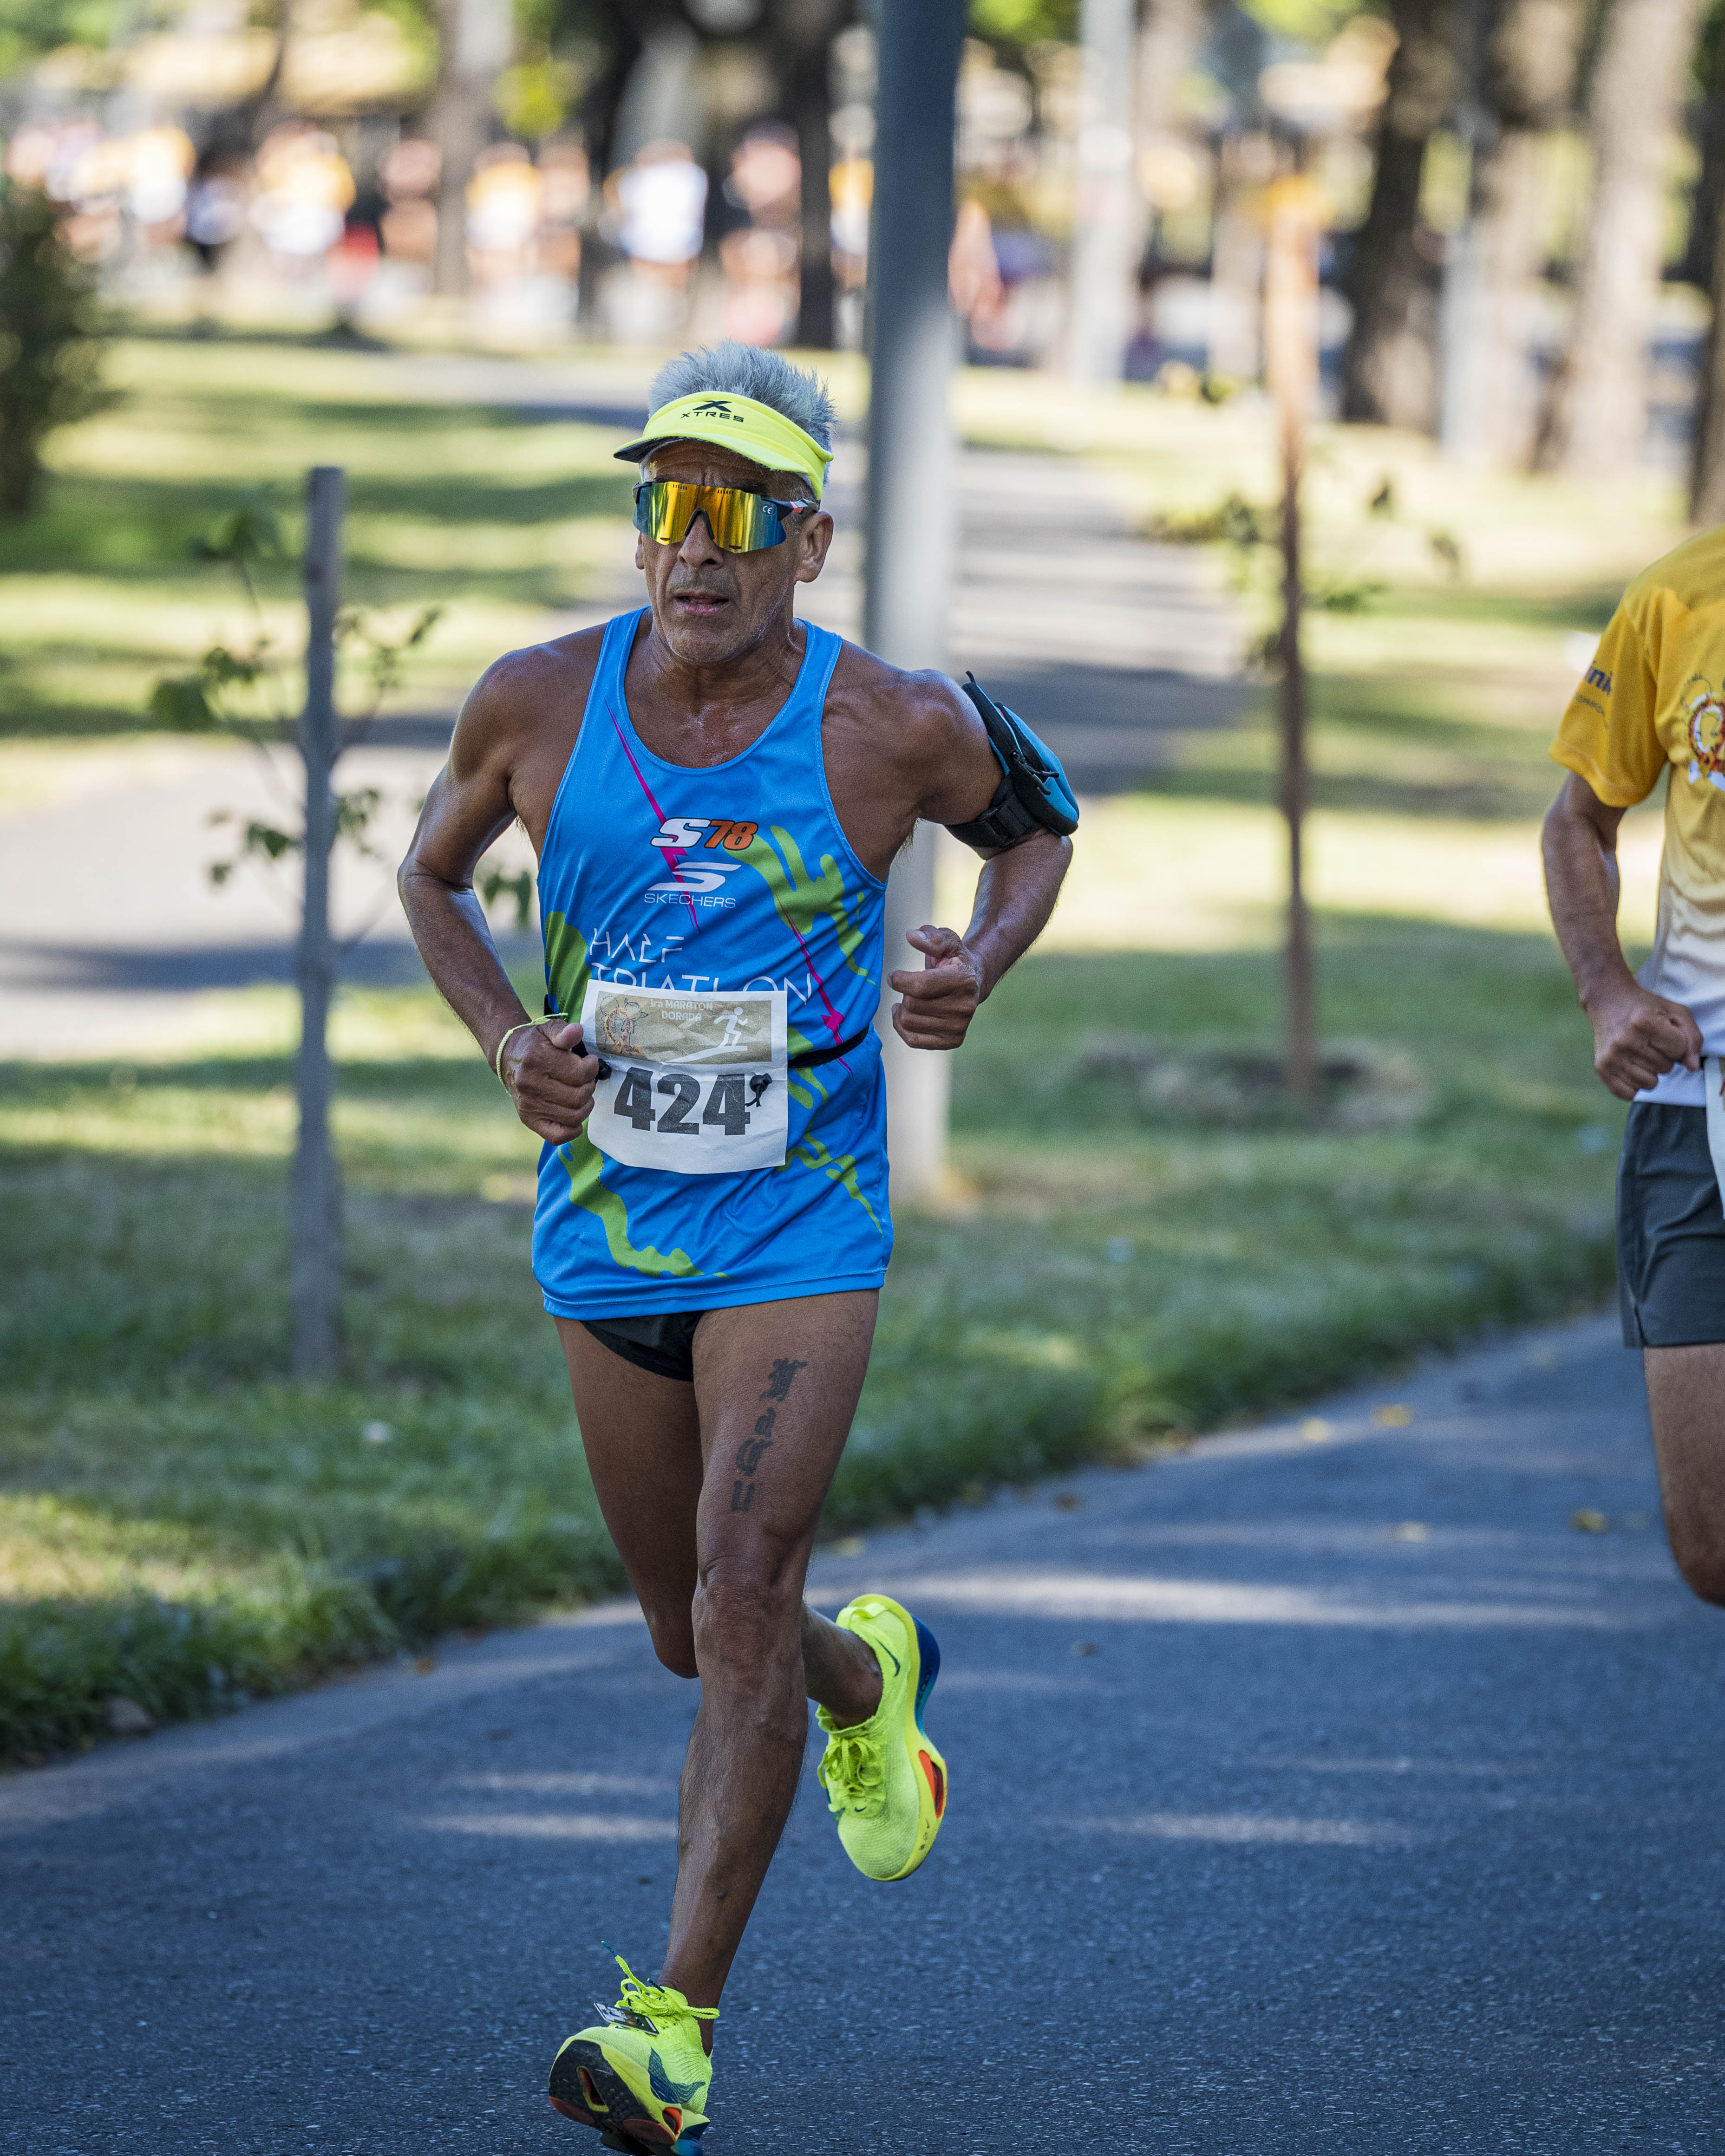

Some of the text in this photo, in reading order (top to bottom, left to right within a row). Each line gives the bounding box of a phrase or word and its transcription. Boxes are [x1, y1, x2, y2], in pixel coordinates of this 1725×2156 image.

[680, 411, 745, 423] XTRES
[763, 506, 772, 515] CE
[650, 817, 759, 851] S78
[644, 893, 736, 908] SKECHERS
[589, 928, 684, 963] HALF
[664, 999, 713, 1011] MARATON
[661, 1010, 702, 1022] DORADA
[614, 1067, 751, 1136] 424
